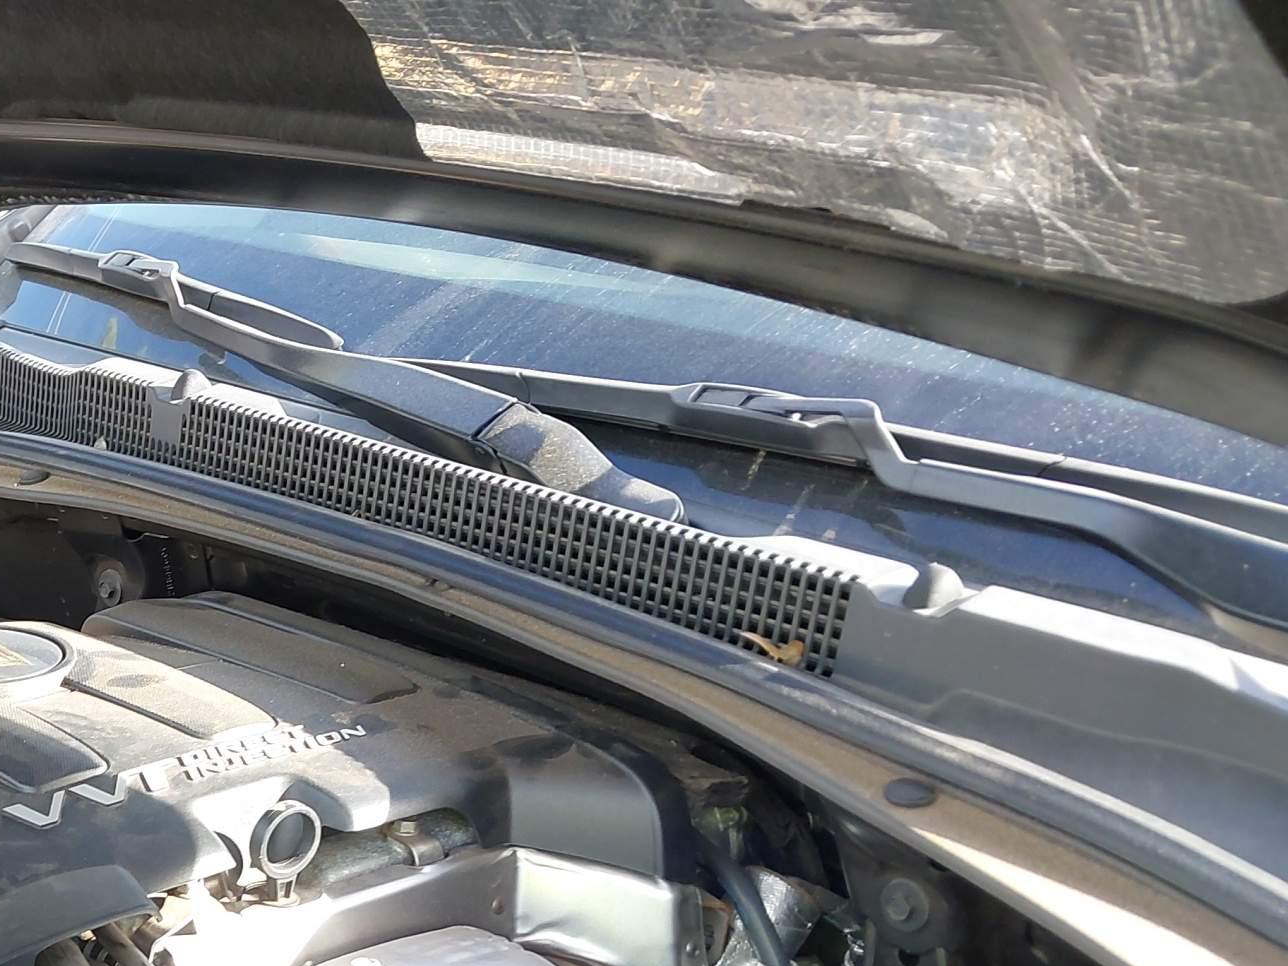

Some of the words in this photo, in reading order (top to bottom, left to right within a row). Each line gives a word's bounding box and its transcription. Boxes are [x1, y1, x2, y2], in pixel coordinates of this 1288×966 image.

[176, 724, 304, 767] DIRECT
[182, 725, 367, 781] INJECTION
[1, 757, 180, 828] VVT
